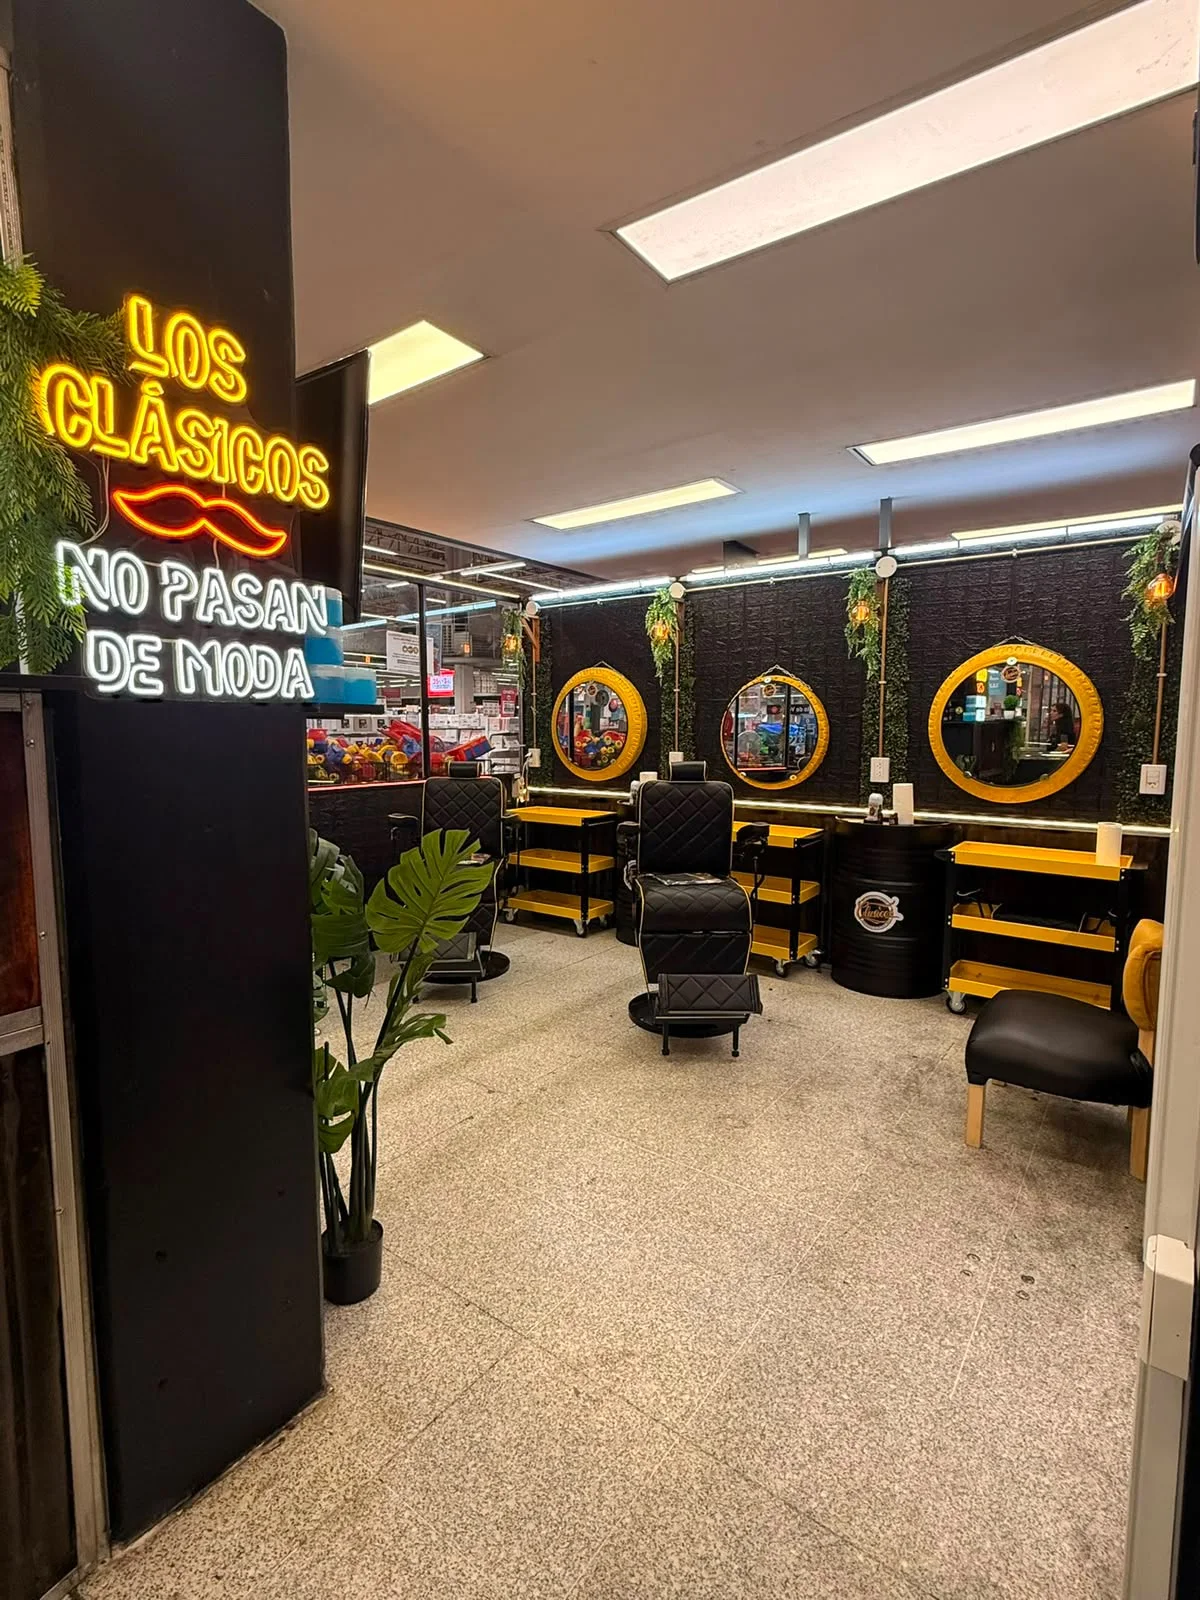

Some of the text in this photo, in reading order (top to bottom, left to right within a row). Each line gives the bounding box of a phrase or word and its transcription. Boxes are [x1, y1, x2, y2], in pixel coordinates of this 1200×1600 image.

[129, 294, 246, 402] LOS
[40, 363, 329, 509] CLÁSICOS
[56, 540, 327, 635] NO PASAN
[86, 629, 314, 699] DE MODA
